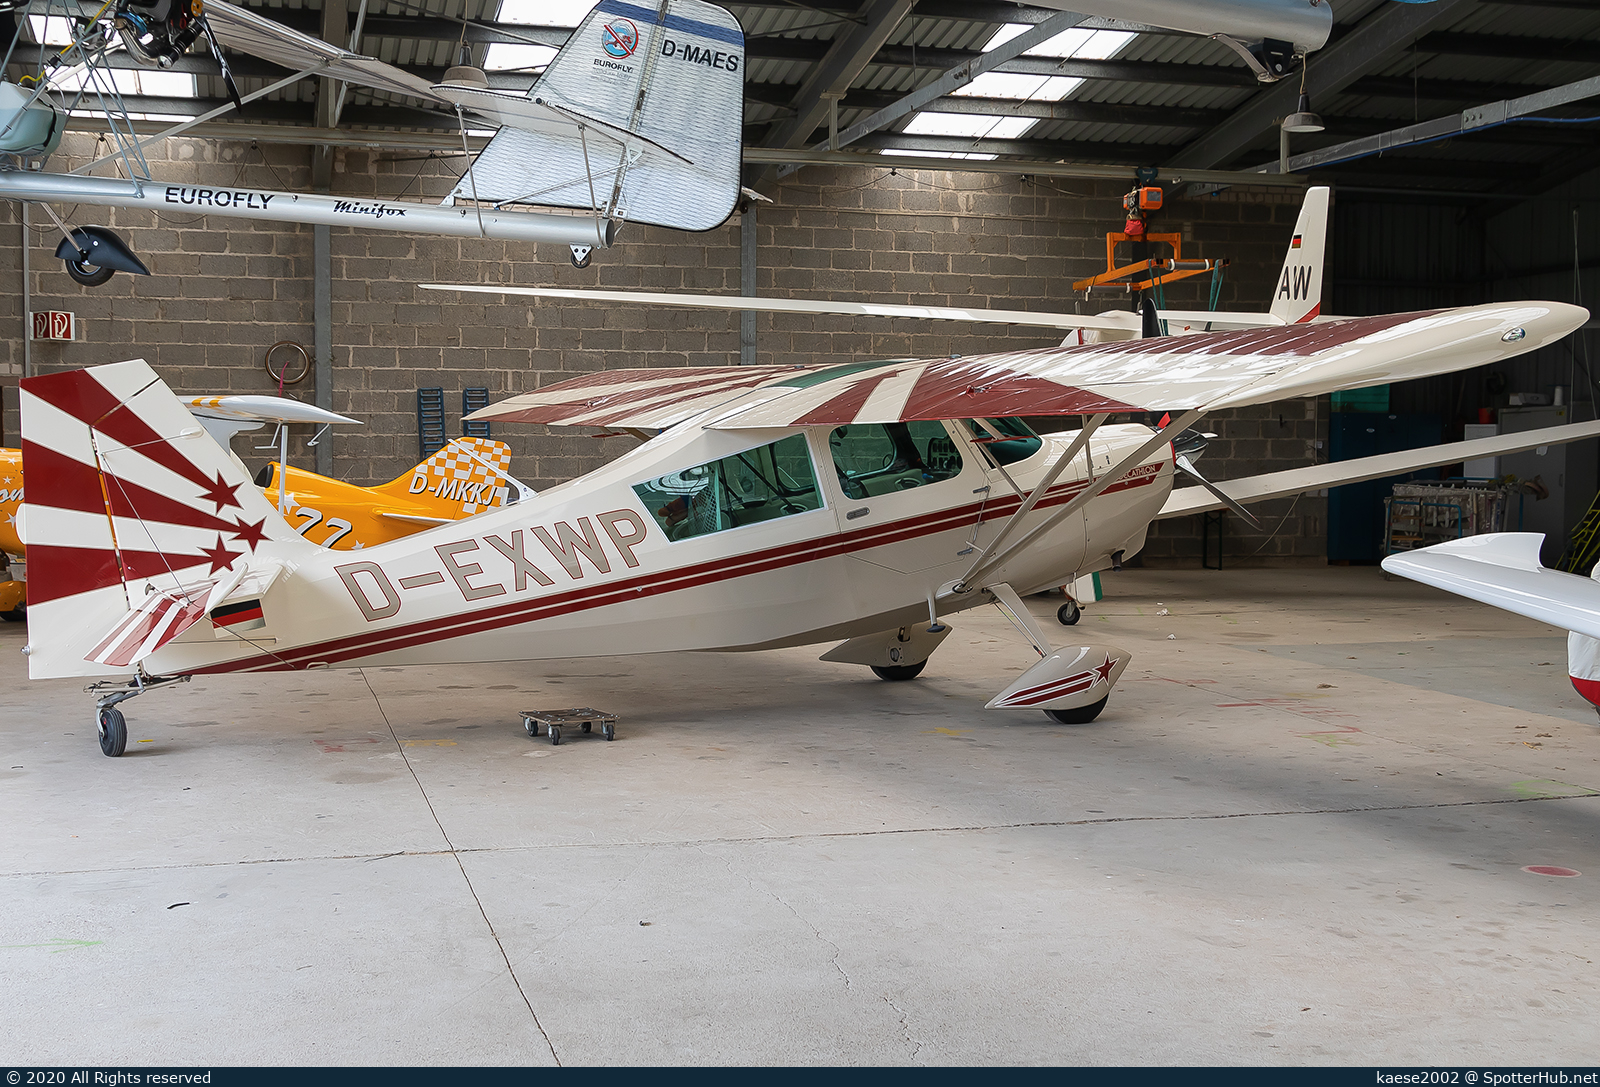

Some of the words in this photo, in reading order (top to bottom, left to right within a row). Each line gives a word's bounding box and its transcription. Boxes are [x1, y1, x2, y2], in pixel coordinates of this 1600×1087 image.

[593, 58, 633, 73] EUROFLY
[661, 39, 739, 72] D-MAES
[165, 187, 275, 210] EUROFLY
[332, 200, 407, 219] Minifox
[1278, 265, 1312, 301] AW
[408, 473, 497, 506] D-MKKJ
[296, 507, 353, 548] 77
[333, 508, 647, 622] D-EXWP
